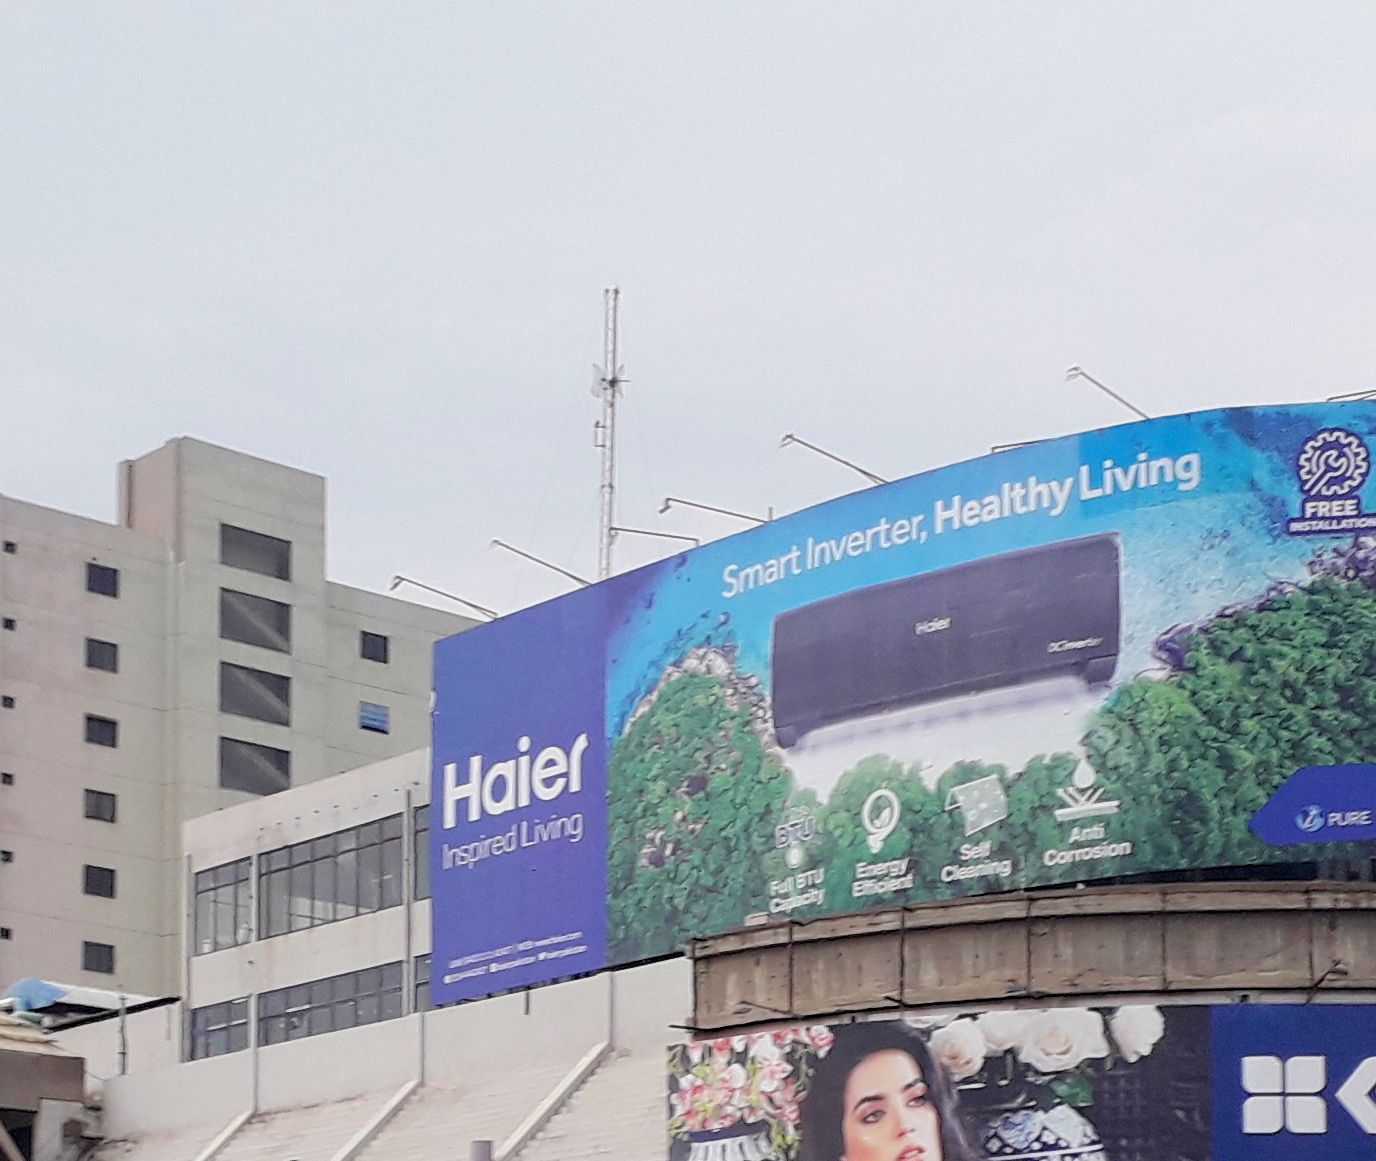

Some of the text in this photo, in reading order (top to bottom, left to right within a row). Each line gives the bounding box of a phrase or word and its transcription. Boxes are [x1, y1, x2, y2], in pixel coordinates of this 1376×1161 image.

[1305, 499, 1359, 518] FREE
[721, 452, 1201, 599] Smart Inverter, Healthy Living
[915, 617, 951, 635] Haier
[443, 733, 589, 829] Haier
[1327, 810, 1373, 826] PURE
[442, 812, 584, 871] Inspired Living
[1069, 823, 1106, 844] Anti
[960, 840, 992, 860] Self
[1043, 841, 1132, 866] Corrosion
[795, 867, 825, 890] BTU
[855, 857, 911, 879] Energy
[941, 860, 1012, 882] Cleaning
